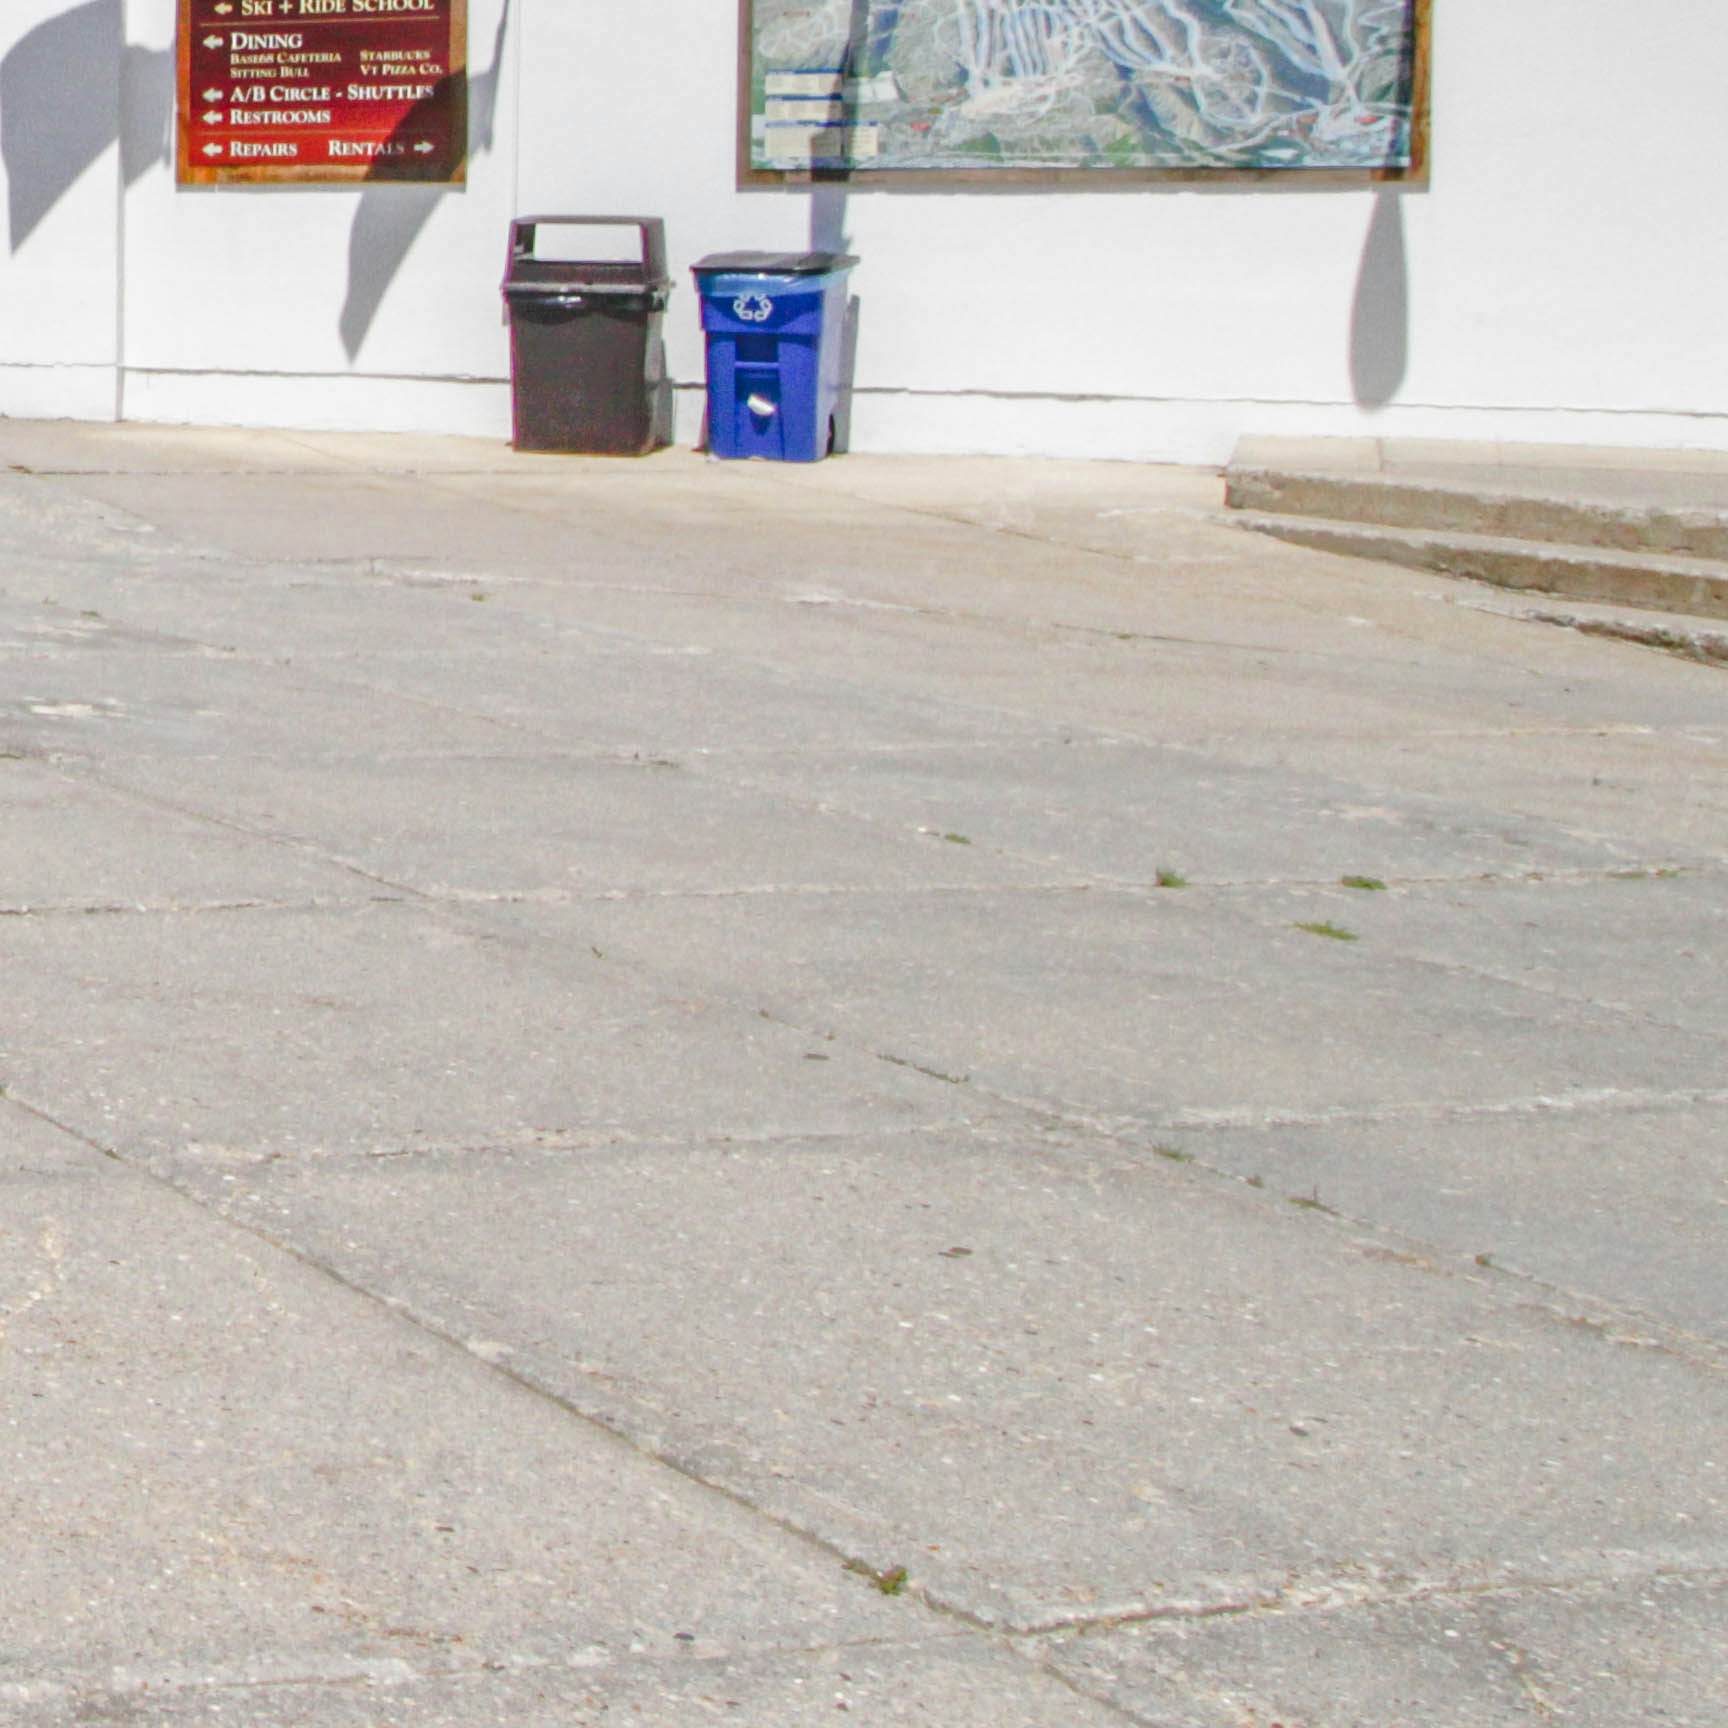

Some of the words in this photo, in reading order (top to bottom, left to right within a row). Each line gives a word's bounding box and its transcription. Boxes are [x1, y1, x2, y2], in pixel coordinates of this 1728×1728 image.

[230, 32, 303, 50] DINING
[276, 51, 342, 63] CAFETERIA
[359, 49, 431, 62] STARBUCKS
[230, 67, 277, 79] SITTING
[280, 66, 310, 78] BULL
[382, 63, 416, 76] PIZZA
[230, 84, 266, 103] A/B
[269, 84, 331, 102] CIRCLE
[347, 83, 434, 101] SHUTTLES
[230, 108, 331, 125] RESTROOMS
[230, 140, 298, 157] REPAIRS
[328, 139, 404, 156] RENTALS
